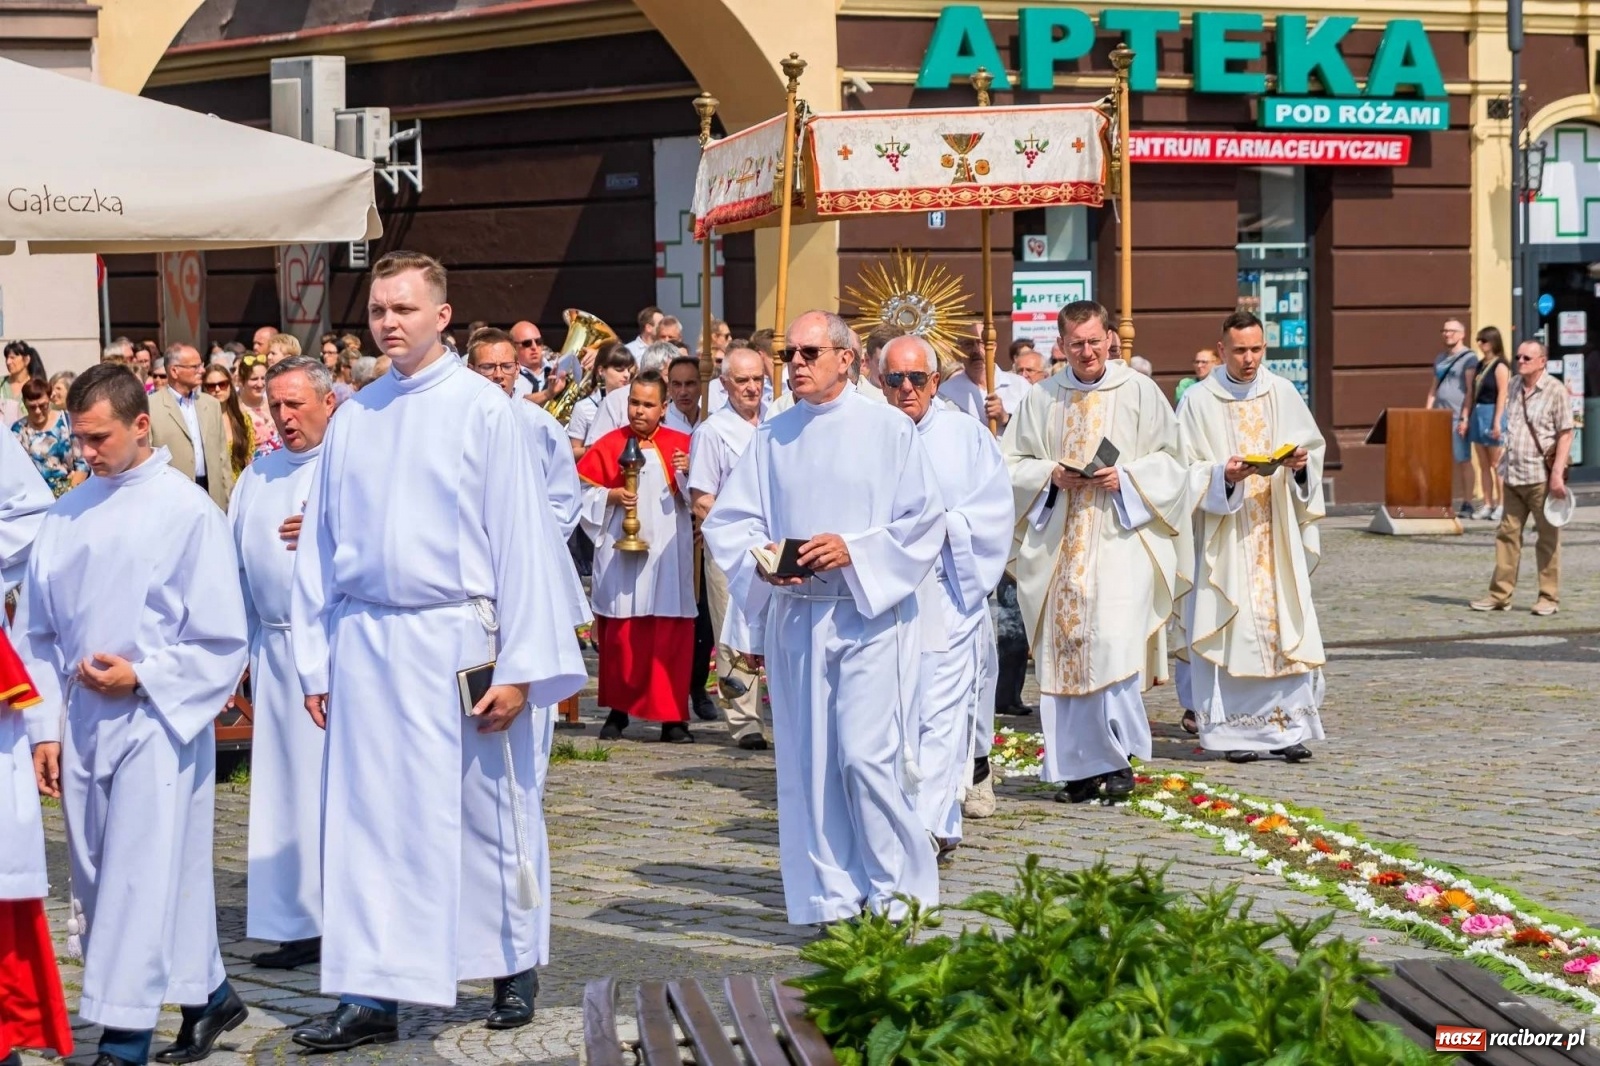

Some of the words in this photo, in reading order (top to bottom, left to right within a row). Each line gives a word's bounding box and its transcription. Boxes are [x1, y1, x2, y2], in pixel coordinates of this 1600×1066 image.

[915, 5, 1447, 96] APTEKA
[1275, 104, 1331, 123] POD
[1338, 101, 1441, 125] RÓŻAMI
[1128, 136, 1211, 158] ENTRUM
[1215, 137, 1403, 160] FARMACEUTYCZNE
[1029, 293, 1080, 303] APTEKA
